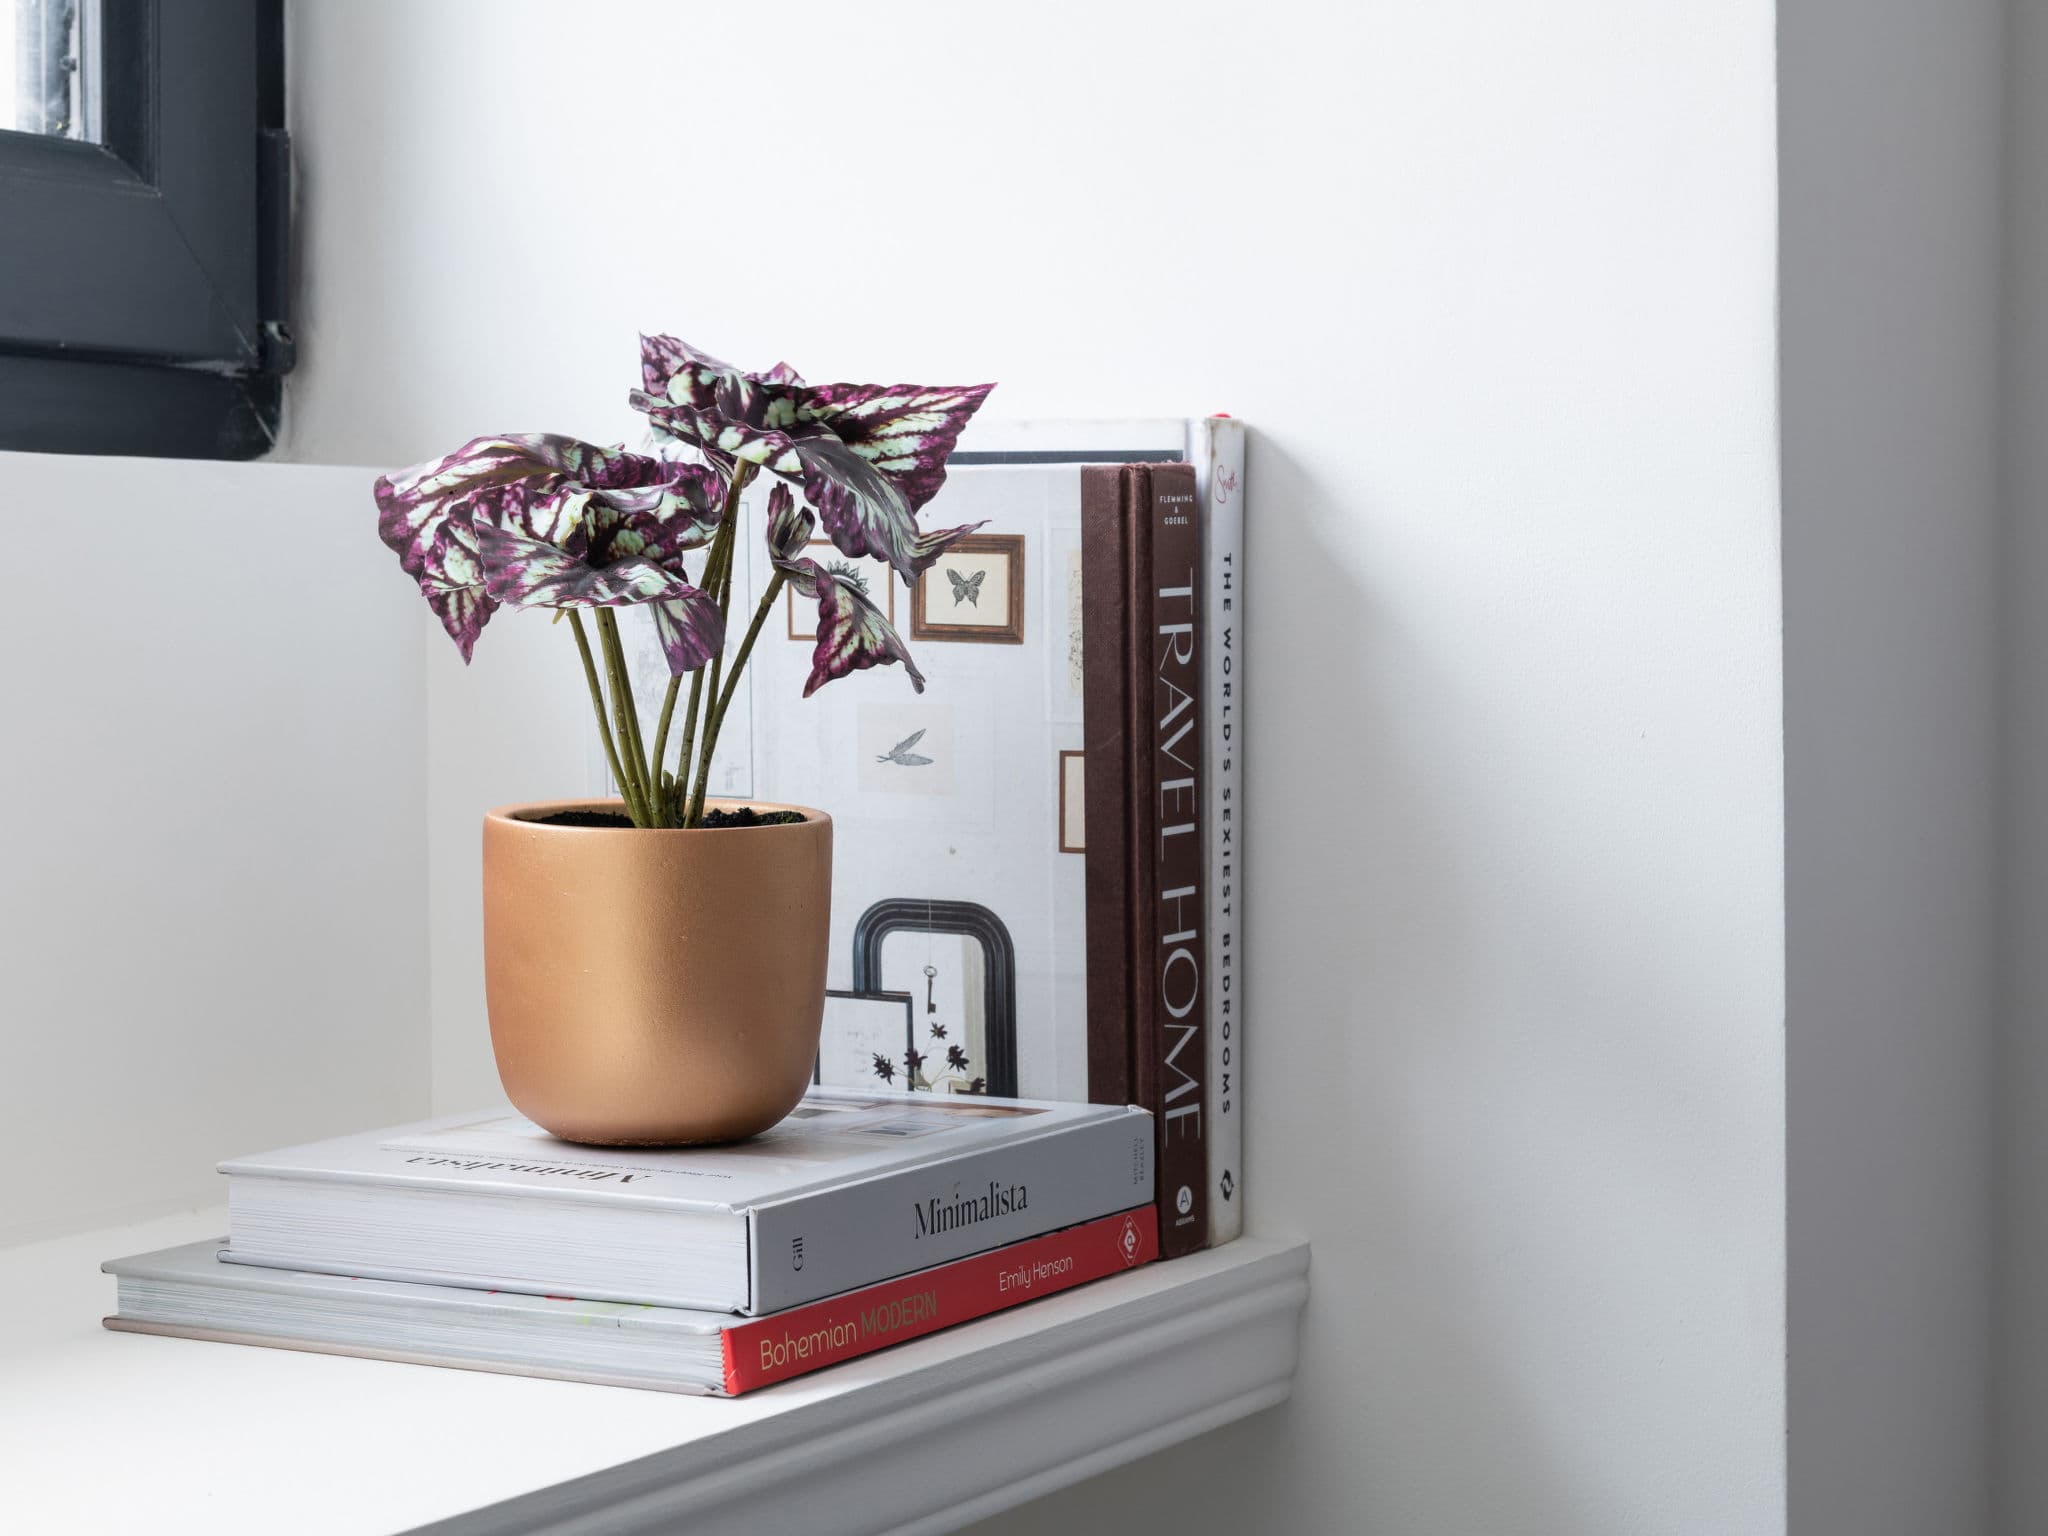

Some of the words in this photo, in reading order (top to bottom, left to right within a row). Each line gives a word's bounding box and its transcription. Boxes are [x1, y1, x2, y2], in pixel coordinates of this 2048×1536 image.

[1160, 494, 1193, 503] FLEMMING
[1164, 516, 1189, 525] GOEBEL
[1223, 552, 1232, 612] THE
[1159, 567, 1195, 862] TRAVEL
[1223, 627, 1232, 771] WORLD'S
[1222, 787, 1232, 917] SEXIEST
[1162, 886, 1200, 1148] HOME
[1222, 932, 1231, 1114] BEDROOMS
[914, 1180, 1028, 1240] Minimalista
[792, 1237, 803, 1271] Gill
[999, 1267, 1031, 1292] Emily
[1033, 1255, 1073, 1280] Henson
[760, 1319, 857, 1371] Bohemian
[861, 1289, 938, 1337] MODERN
